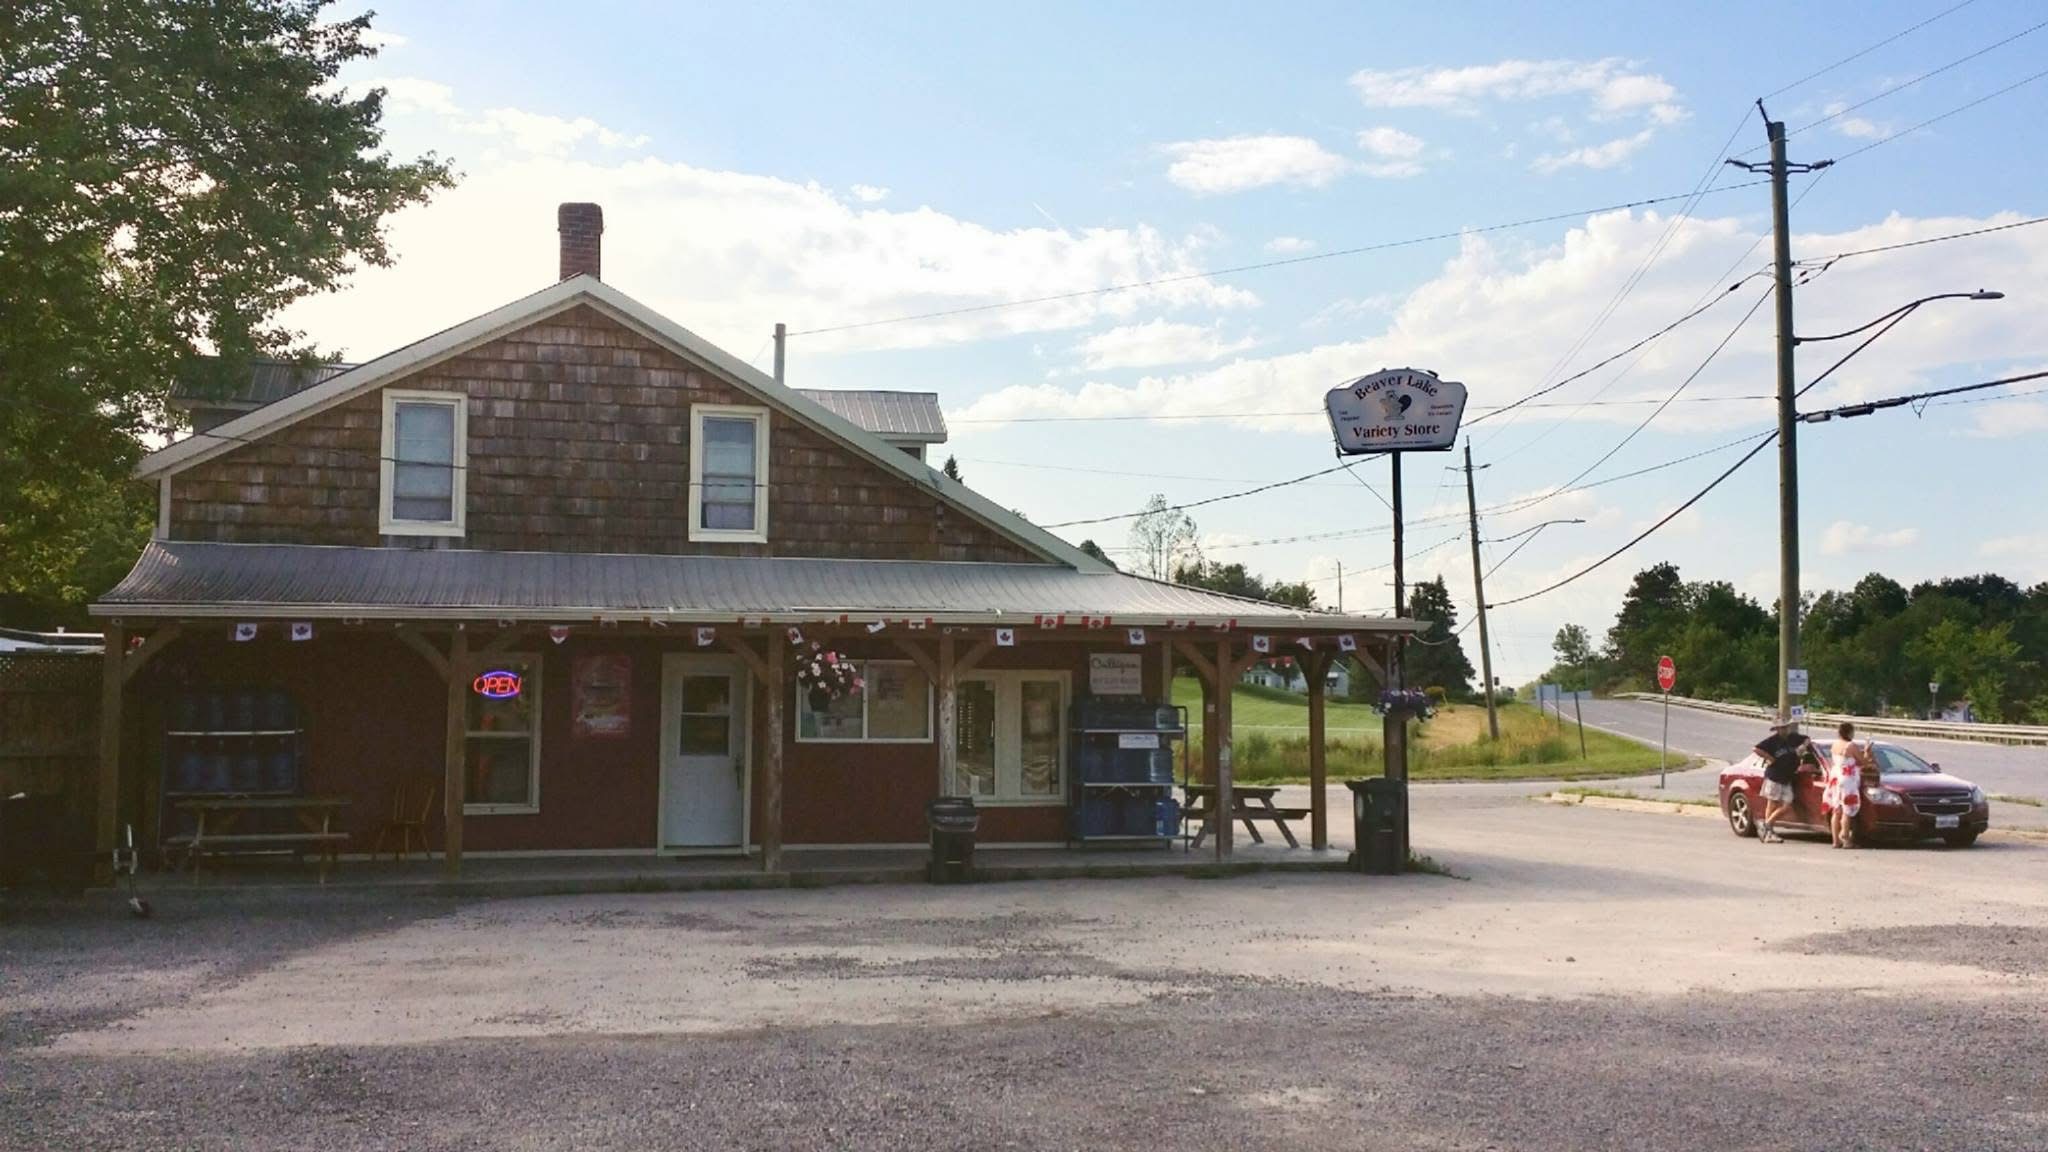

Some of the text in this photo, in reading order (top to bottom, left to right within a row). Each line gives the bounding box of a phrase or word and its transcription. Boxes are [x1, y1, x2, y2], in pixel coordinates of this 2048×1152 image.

[1354, 375, 1438, 400] Beaver Lake
[1353, 423, 1440, 439] Variety Store
[1658, 666, 1674, 679] STOP
[473, 676, 522, 693] OPEN
